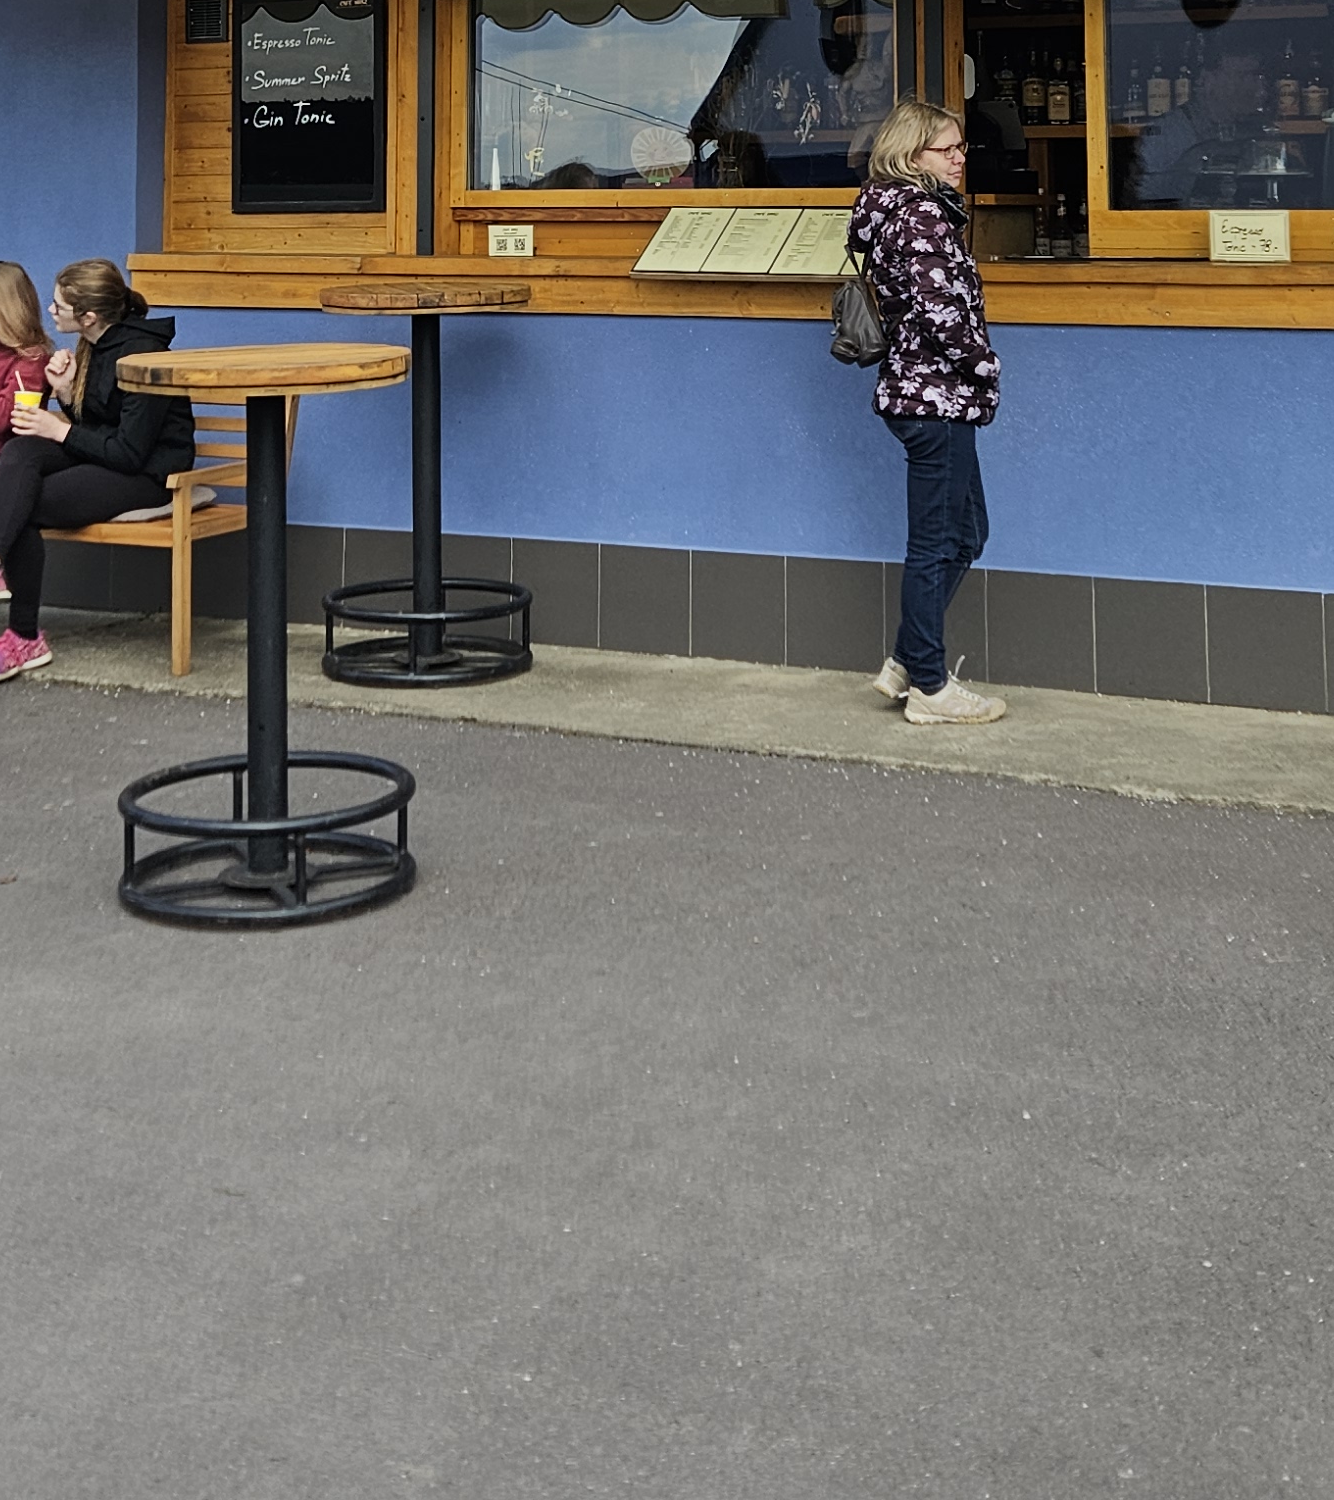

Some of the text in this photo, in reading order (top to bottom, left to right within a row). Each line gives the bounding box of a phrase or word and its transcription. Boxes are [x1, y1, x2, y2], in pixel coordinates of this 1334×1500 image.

[253, 27, 335, 55] Espresso Tonic
[251, 63, 351, 90] Summer Spritz
[253, 101, 336, 128] Gin Tonic
